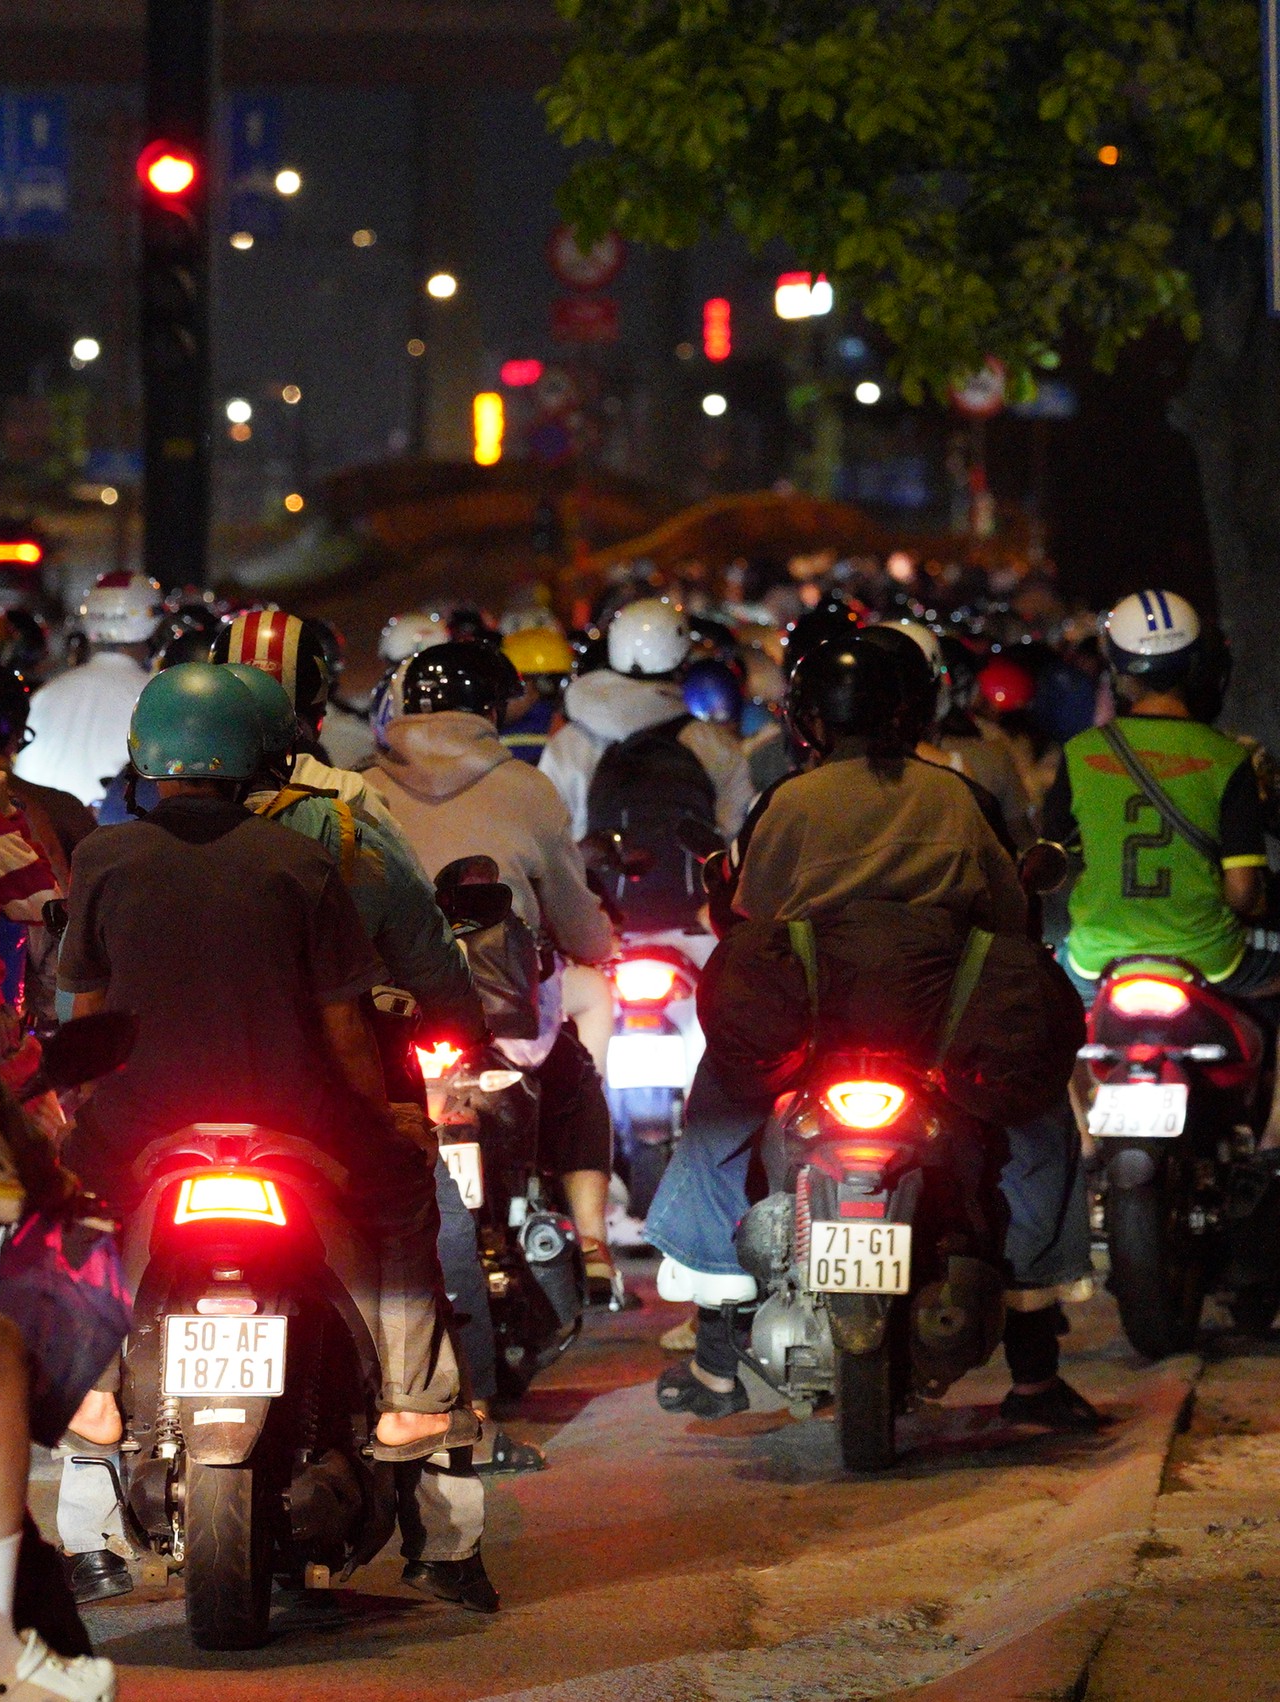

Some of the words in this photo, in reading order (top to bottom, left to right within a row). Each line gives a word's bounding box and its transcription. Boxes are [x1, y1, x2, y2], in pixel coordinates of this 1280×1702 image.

[1122, 794, 1172, 898] 2
[825, 1226, 895, 1256] 71-G1
[816, 1258, 901, 1289] 051.11
[184, 1321, 269, 1352] 50-AF
[177, 1358, 273, 1389] 187.61
